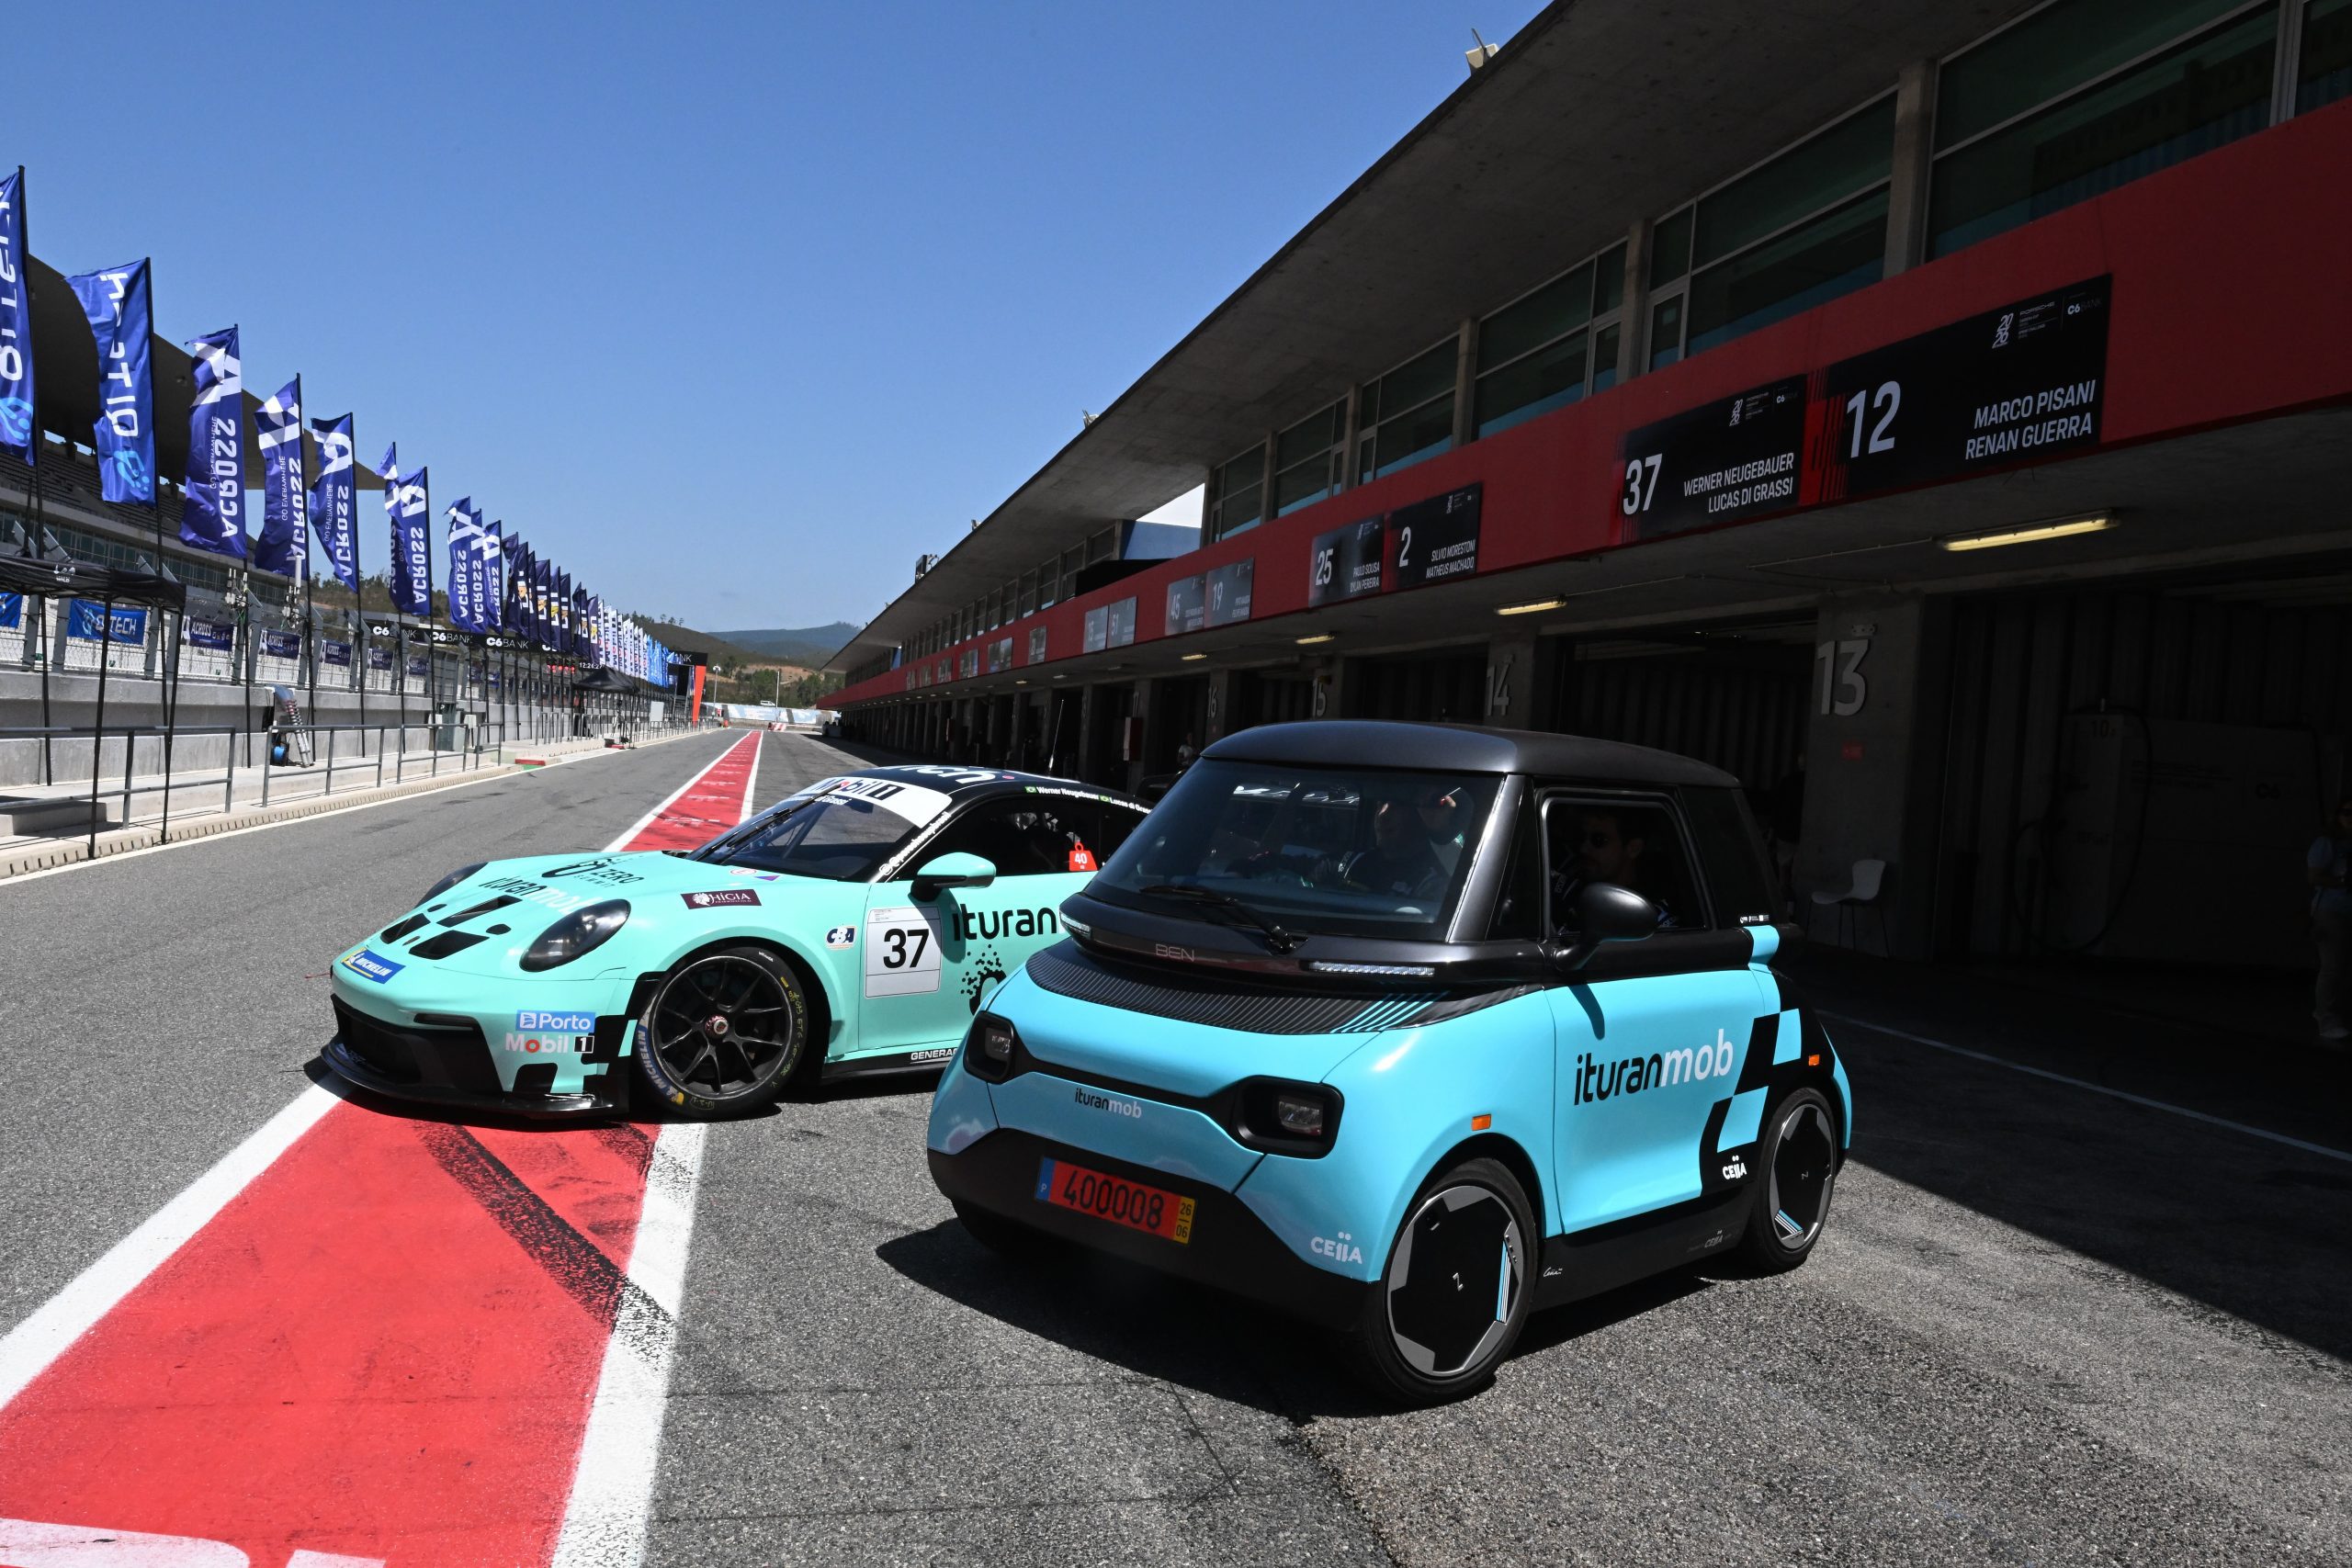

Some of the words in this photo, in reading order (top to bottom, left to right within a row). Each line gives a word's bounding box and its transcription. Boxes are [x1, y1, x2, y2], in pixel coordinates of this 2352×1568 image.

[2067, 303, 2081, 315] C6
[1973, 399, 2034, 430] MARCO
[2035, 379, 2096, 417] PISANI
[1845, 379, 1902, 459] 12
[1965, 430, 2019, 460] RENAN
[2021, 412, 2093, 449] GUERRA
[1623, 453, 1662, 515] 37
[1683, 469, 1723, 498] WERNER
[1724, 453, 1794, 491] NEUGEBAUER
[1708, 491, 1741, 514] LUCAS
[1741, 488, 1753, 507] DI
[1753, 476, 1793, 505] GRASSI
[1398, 526, 1412, 568] 2
[1316, 548, 1334, 586] 25
[1426, 561, 1449, 580] MATHEUS
[1449, 557, 1476, 575] MACHADO
[1213, 581, 1224, 612] 19
[96, 614, 137, 636] QTECH
[190, 622, 213, 637] ACROSS
[372, 626, 390, 637] C6
[431, 631, 447, 642] C6
[486, 637, 503, 648] C6
[1816, 637, 1870, 716] 13
[1486, 661, 1511, 718] 14
[1036, 786, 1061, 795] Werner
[1061, 787, 1100, 802] Neugebauer
[1110, 796, 1128, 808] Lucas
[1074, 852, 1088, 864] 40
[591, 868, 645, 884] ZERO
[952, 903, 1060, 942] ituran
[883, 928, 930, 969] 37
[1155, 943, 1195, 963] BEN
[354, 957, 393, 976] MICHELIN
[538, 1012, 591, 1031] Porto
[505, 1032, 569, 1054] Mobil
[638, 1030, 667, 1089] MICHELIN
[1573, 1028, 1735, 1106] ituranmob
[1074, 1088, 1142, 1120] ituranmob
[1041, 1182, 1047, 1192] P
[1063, 1169, 1165, 1230] 400008
[1180, 1201, 1193, 1216] 26
[1175, 1224, 1188, 1238] 06
